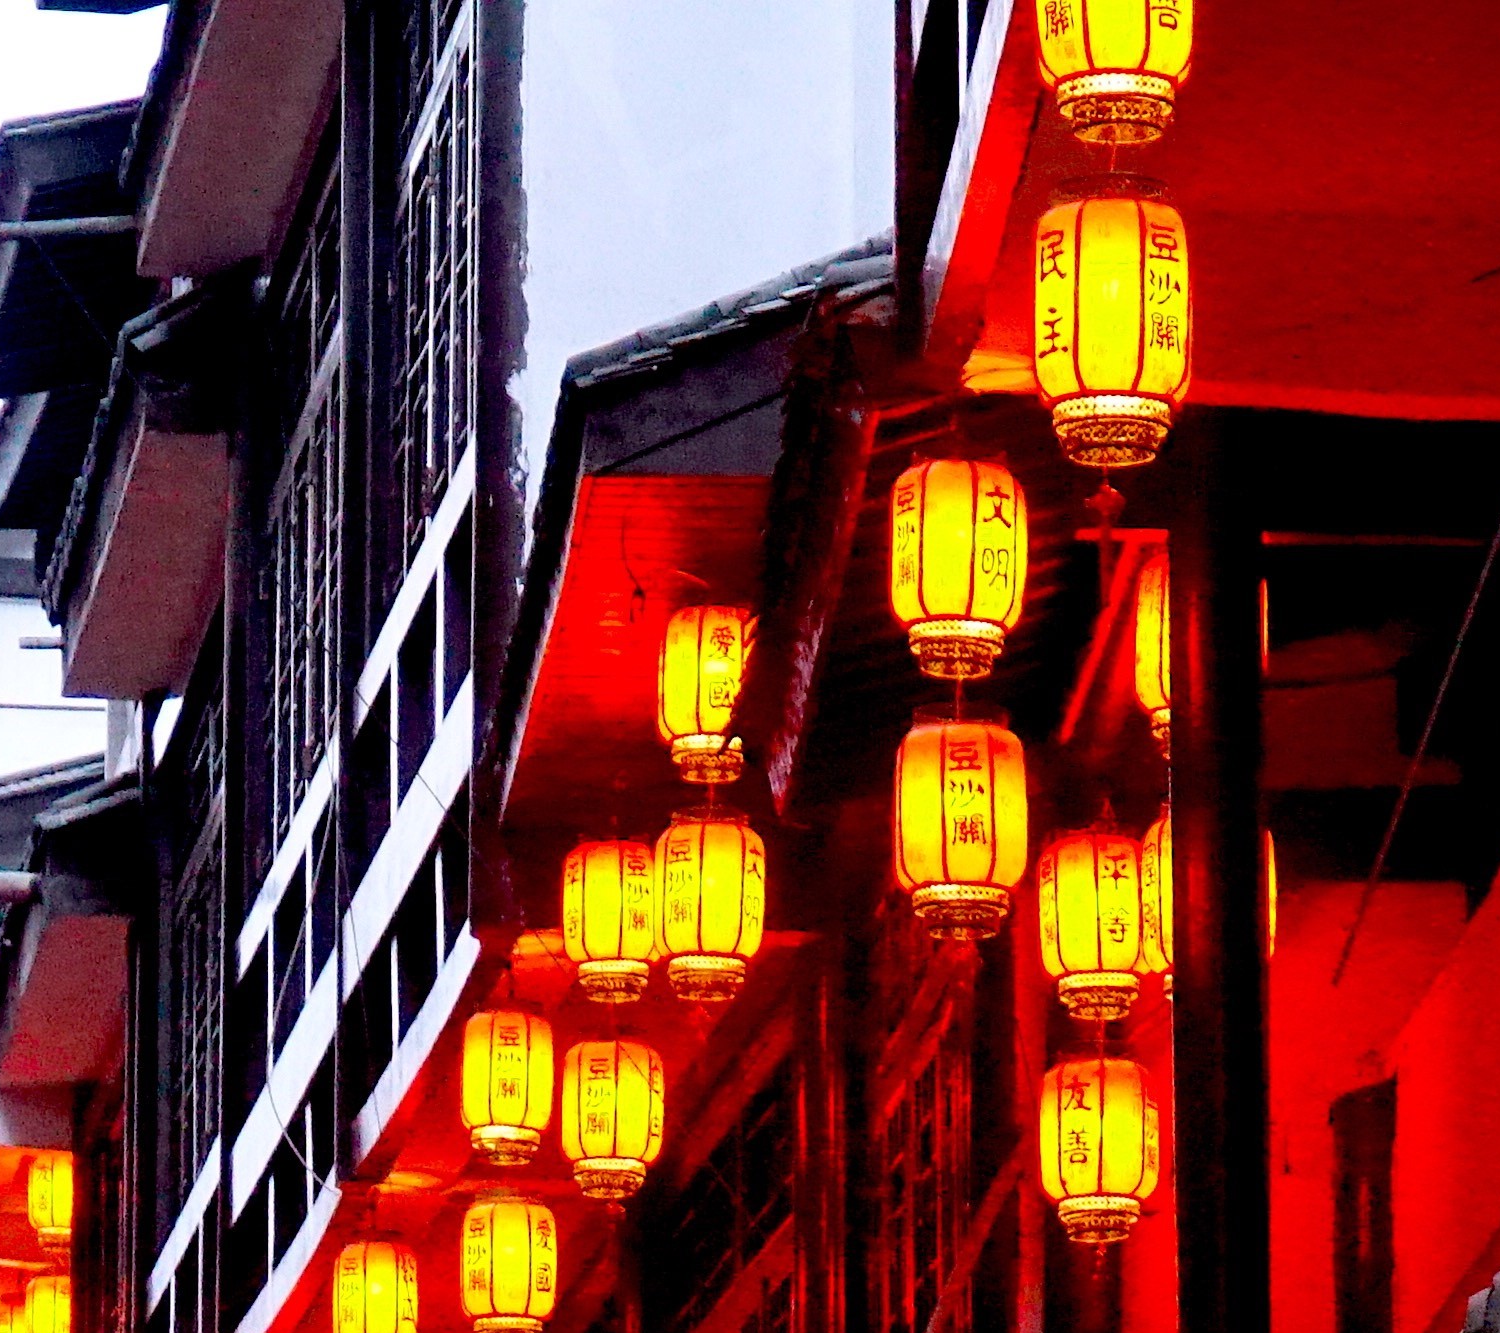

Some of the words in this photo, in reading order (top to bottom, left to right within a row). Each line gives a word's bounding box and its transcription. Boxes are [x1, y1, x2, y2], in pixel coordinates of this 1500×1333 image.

[1040, 230, 1068, 358] 民主
[1149, 225, 1181, 355] 豆沙關
[981, 486, 1011, 590] 文明
[708, 625, 736, 709] 愛國
[948, 742, 987, 846] 豆沙關
[627, 855, 649, 930] 豆沙關
[669, 839, 693, 924] 豆沙關
[1102, 852, 1130, 943] 平等
[497, 1025, 521, 1100] 豆沙關
[585, 1057, 611, 1136] 豆沙關
[1064, 1076, 1092, 1164] 友善
[467, 1218, 488, 1292] 豆沙關
[535, 1219, 553, 1294] 愛國
